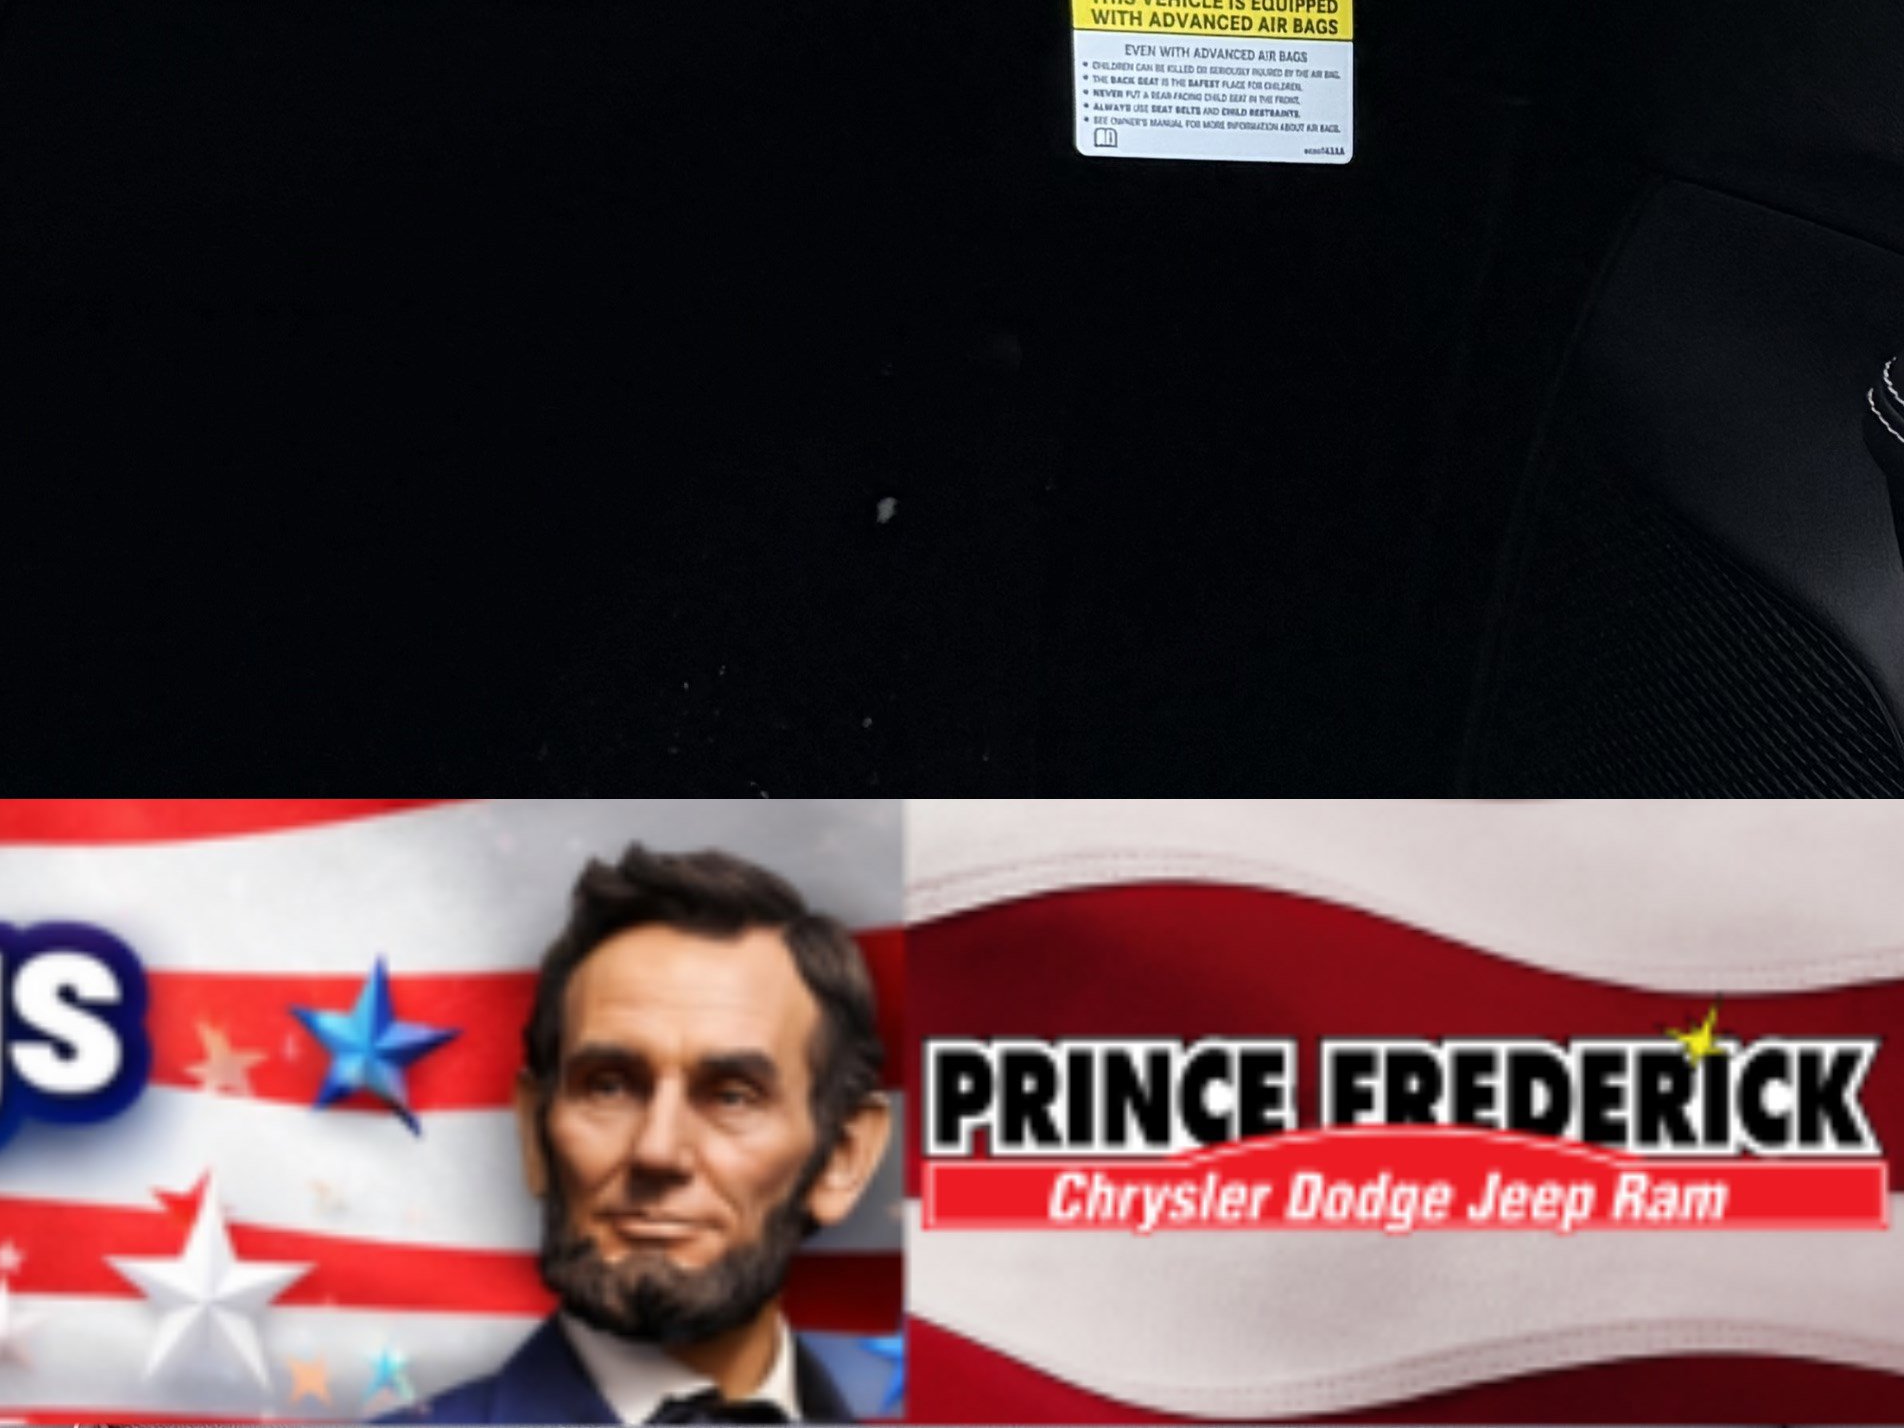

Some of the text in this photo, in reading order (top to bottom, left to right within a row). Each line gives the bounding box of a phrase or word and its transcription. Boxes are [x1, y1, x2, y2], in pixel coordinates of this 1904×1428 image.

[1090, 8, 1339, 35] WITH ADVANCED AIR BAGS
[1124, 43, 1308, 63] EVEN WITH ADVANCED AIR BAGS
